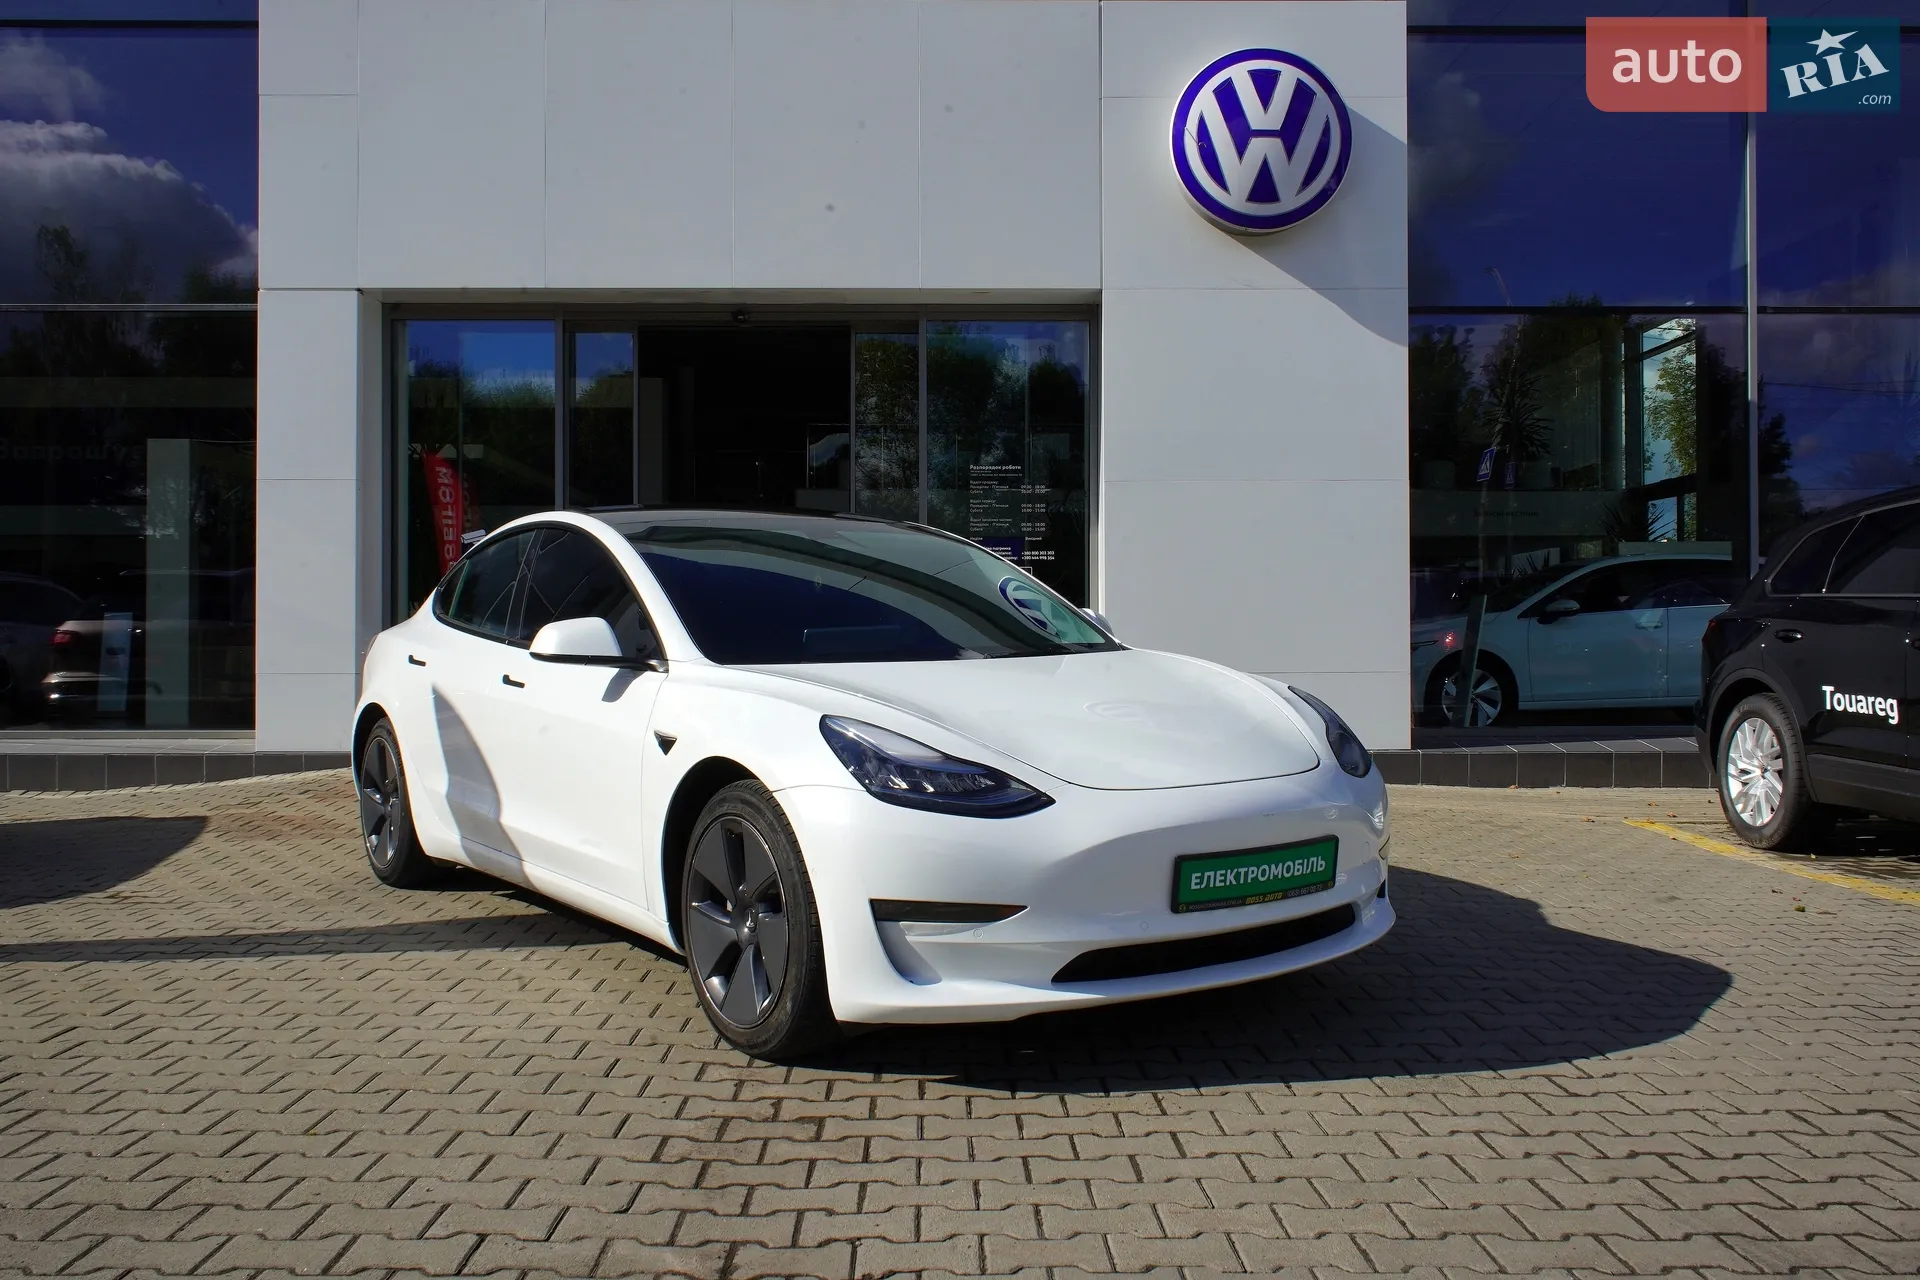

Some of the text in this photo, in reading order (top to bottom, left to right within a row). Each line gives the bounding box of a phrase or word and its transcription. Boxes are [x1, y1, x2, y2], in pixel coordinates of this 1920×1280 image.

[1821, 685, 1899, 725] Touareg
[1190, 855, 1326, 890] ЕЛЕКТРОМОБІЛЬ
[1245, 895, 1263, 904] BOSS
[1265, 892, 1283, 902] AUTO
